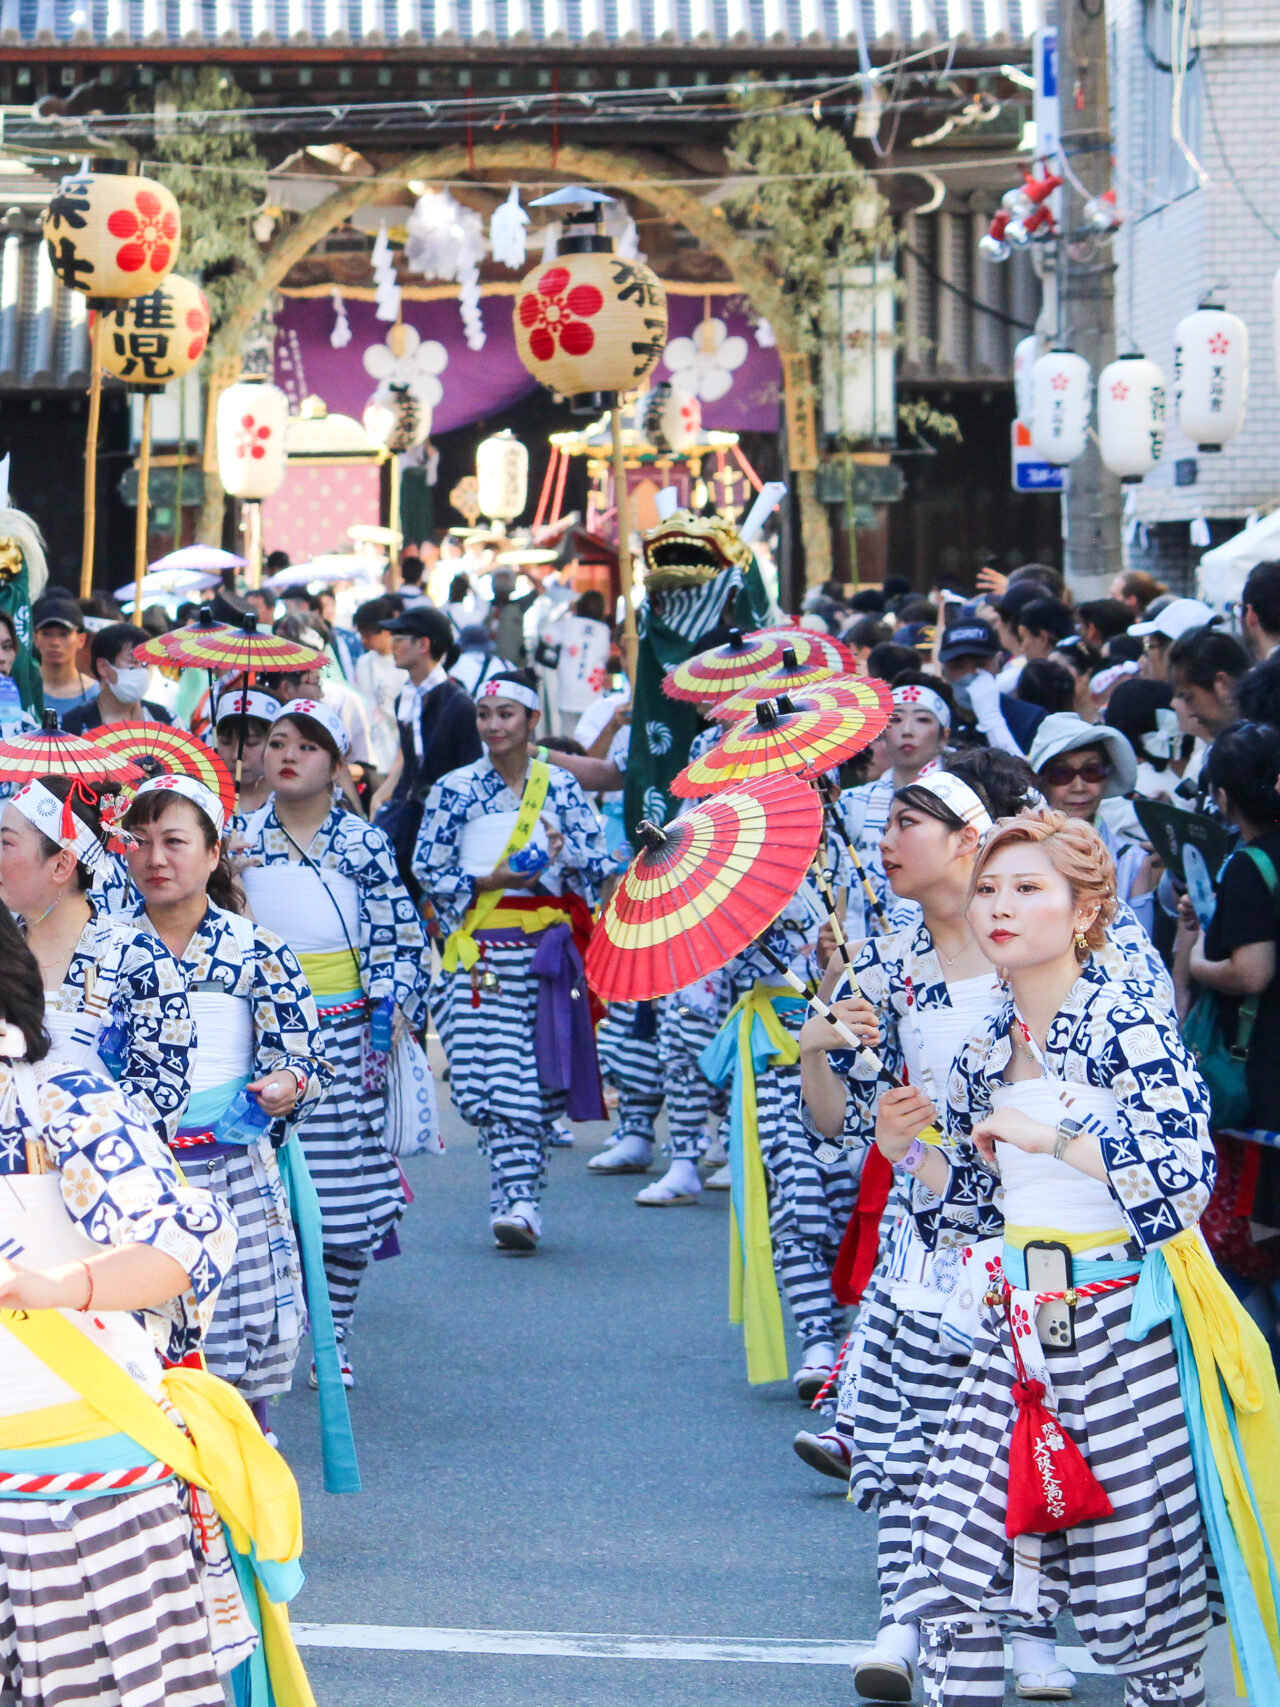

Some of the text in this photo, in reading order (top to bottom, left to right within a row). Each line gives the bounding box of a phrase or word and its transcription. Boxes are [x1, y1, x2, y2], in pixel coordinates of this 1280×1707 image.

[1033, 1437, 1066, 1518] 大阪天満宮
